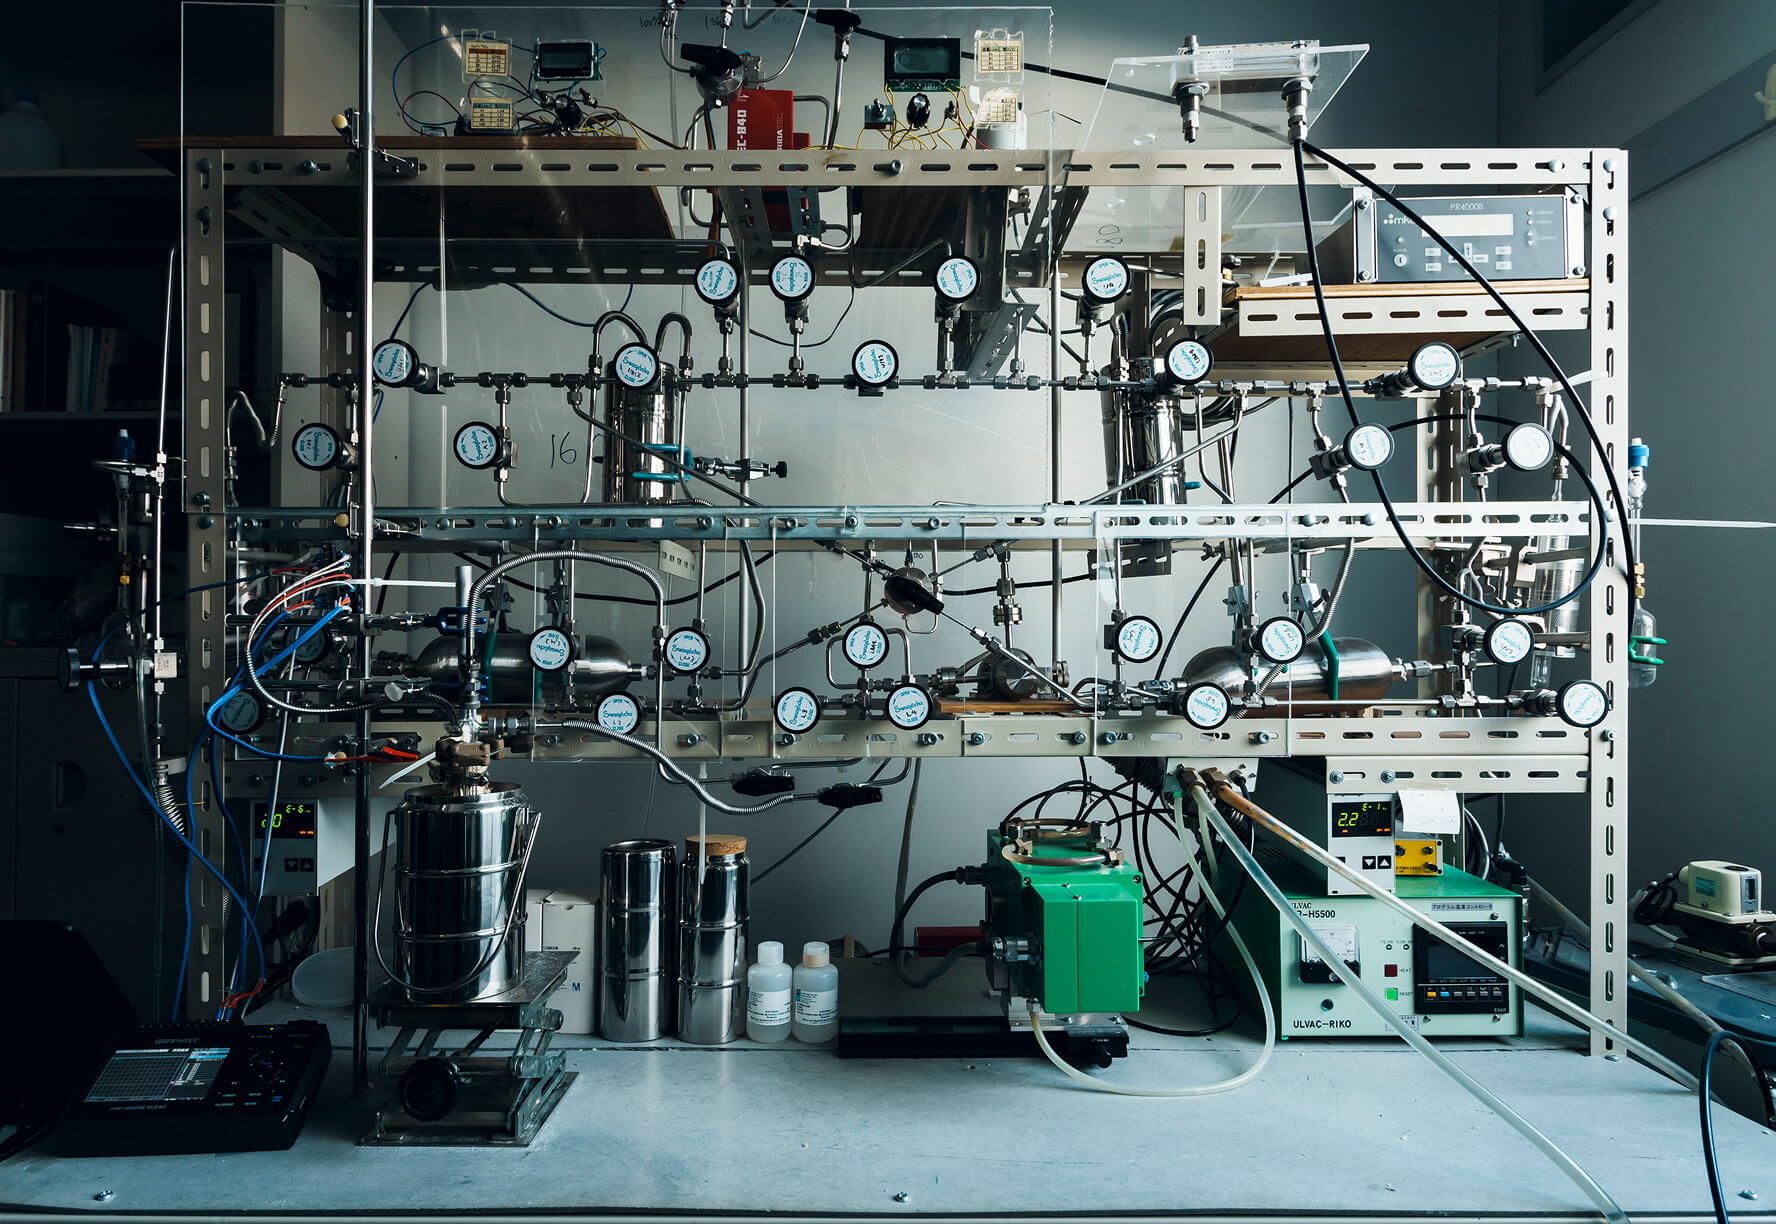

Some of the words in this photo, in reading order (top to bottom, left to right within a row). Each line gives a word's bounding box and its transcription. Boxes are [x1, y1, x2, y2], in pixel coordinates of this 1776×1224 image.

[1450, 203, 1484, 212] PR4000B
[551, 432, 577, 469] 16
[1337, 812, 1359, 827] 2.2
[1293, 1020, 1352, 1029] ULVAC-RIKO
